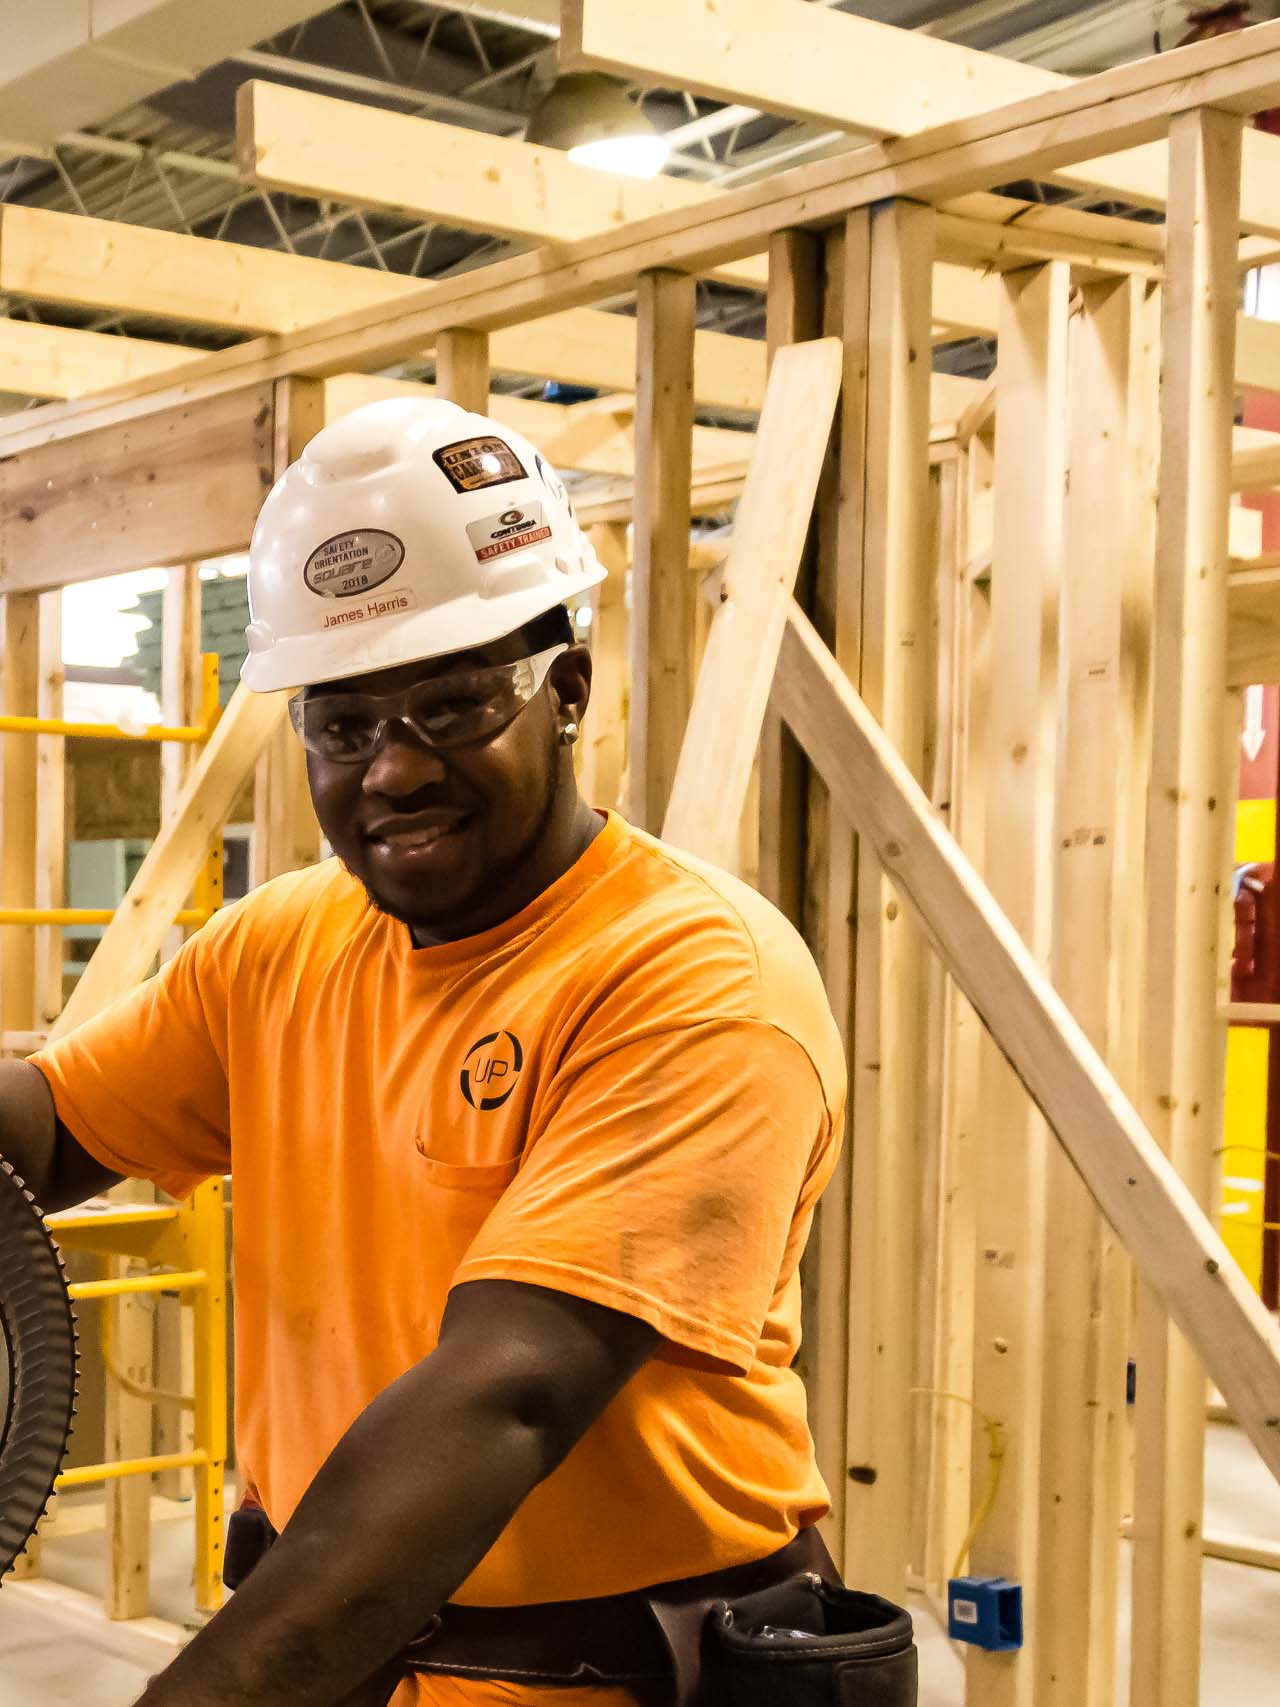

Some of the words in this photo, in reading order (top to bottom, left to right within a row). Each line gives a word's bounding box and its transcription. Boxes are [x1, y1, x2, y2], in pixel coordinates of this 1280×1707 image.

[324, 540, 354, 555] SAFETY
[481, 541, 516, 559] SAFETY
[518, 528, 550, 545] TRAINED
[314, 546, 369, 569] ORIENTATION
[342, 575, 369, 590] 2018
[324, 608, 364, 628] James
[367, 596, 408, 616] Harris
[475, 1058, 508, 1083] UP
